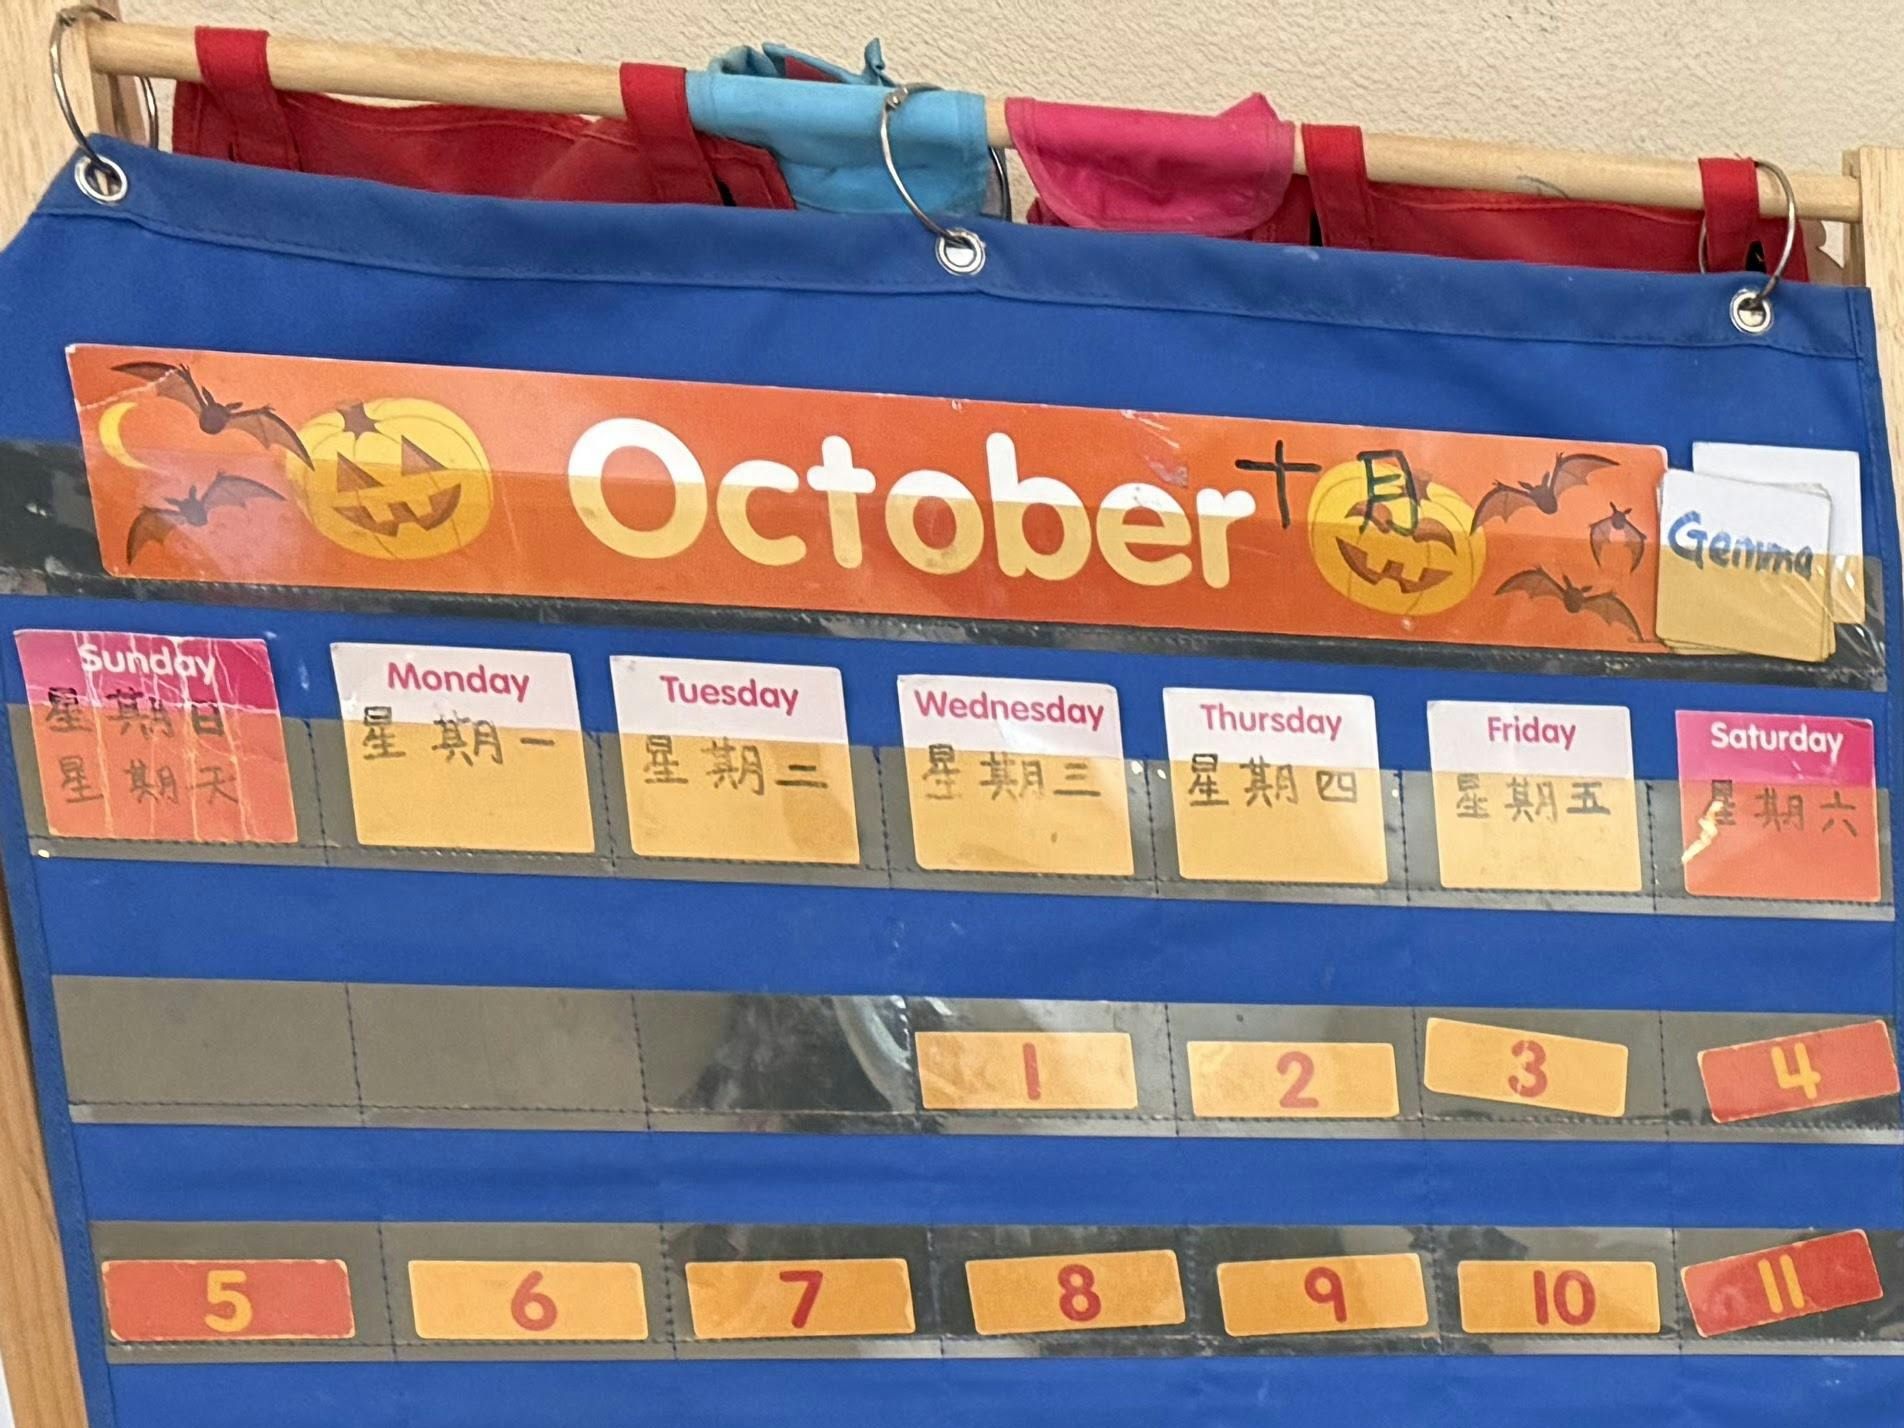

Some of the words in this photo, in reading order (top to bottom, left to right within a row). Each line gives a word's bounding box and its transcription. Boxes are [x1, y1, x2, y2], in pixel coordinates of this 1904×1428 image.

[567, 417, 1254, 589] October
[1235, 441, 1418, 535] 十月
[1667, 510, 1814, 582] Gemma
[82, 643, 216, 685] Sunday
[387, 662, 530, 703] Monday
[659, 675, 799, 717] Tuesday
[914, 689, 1104, 732] Wednesday
[1200, 703, 1343, 741] Thursday
[362, 705, 556, 767] 星期一
[1487, 715, 1576, 751] Friday
[1710, 721, 1844, 765] Saturday
[57, 754, 240, 804] 星期天
[643, 734, 829, 796] 星期二
[921, 743, 1102, 800] 星期三
[1188, 753, 1358, 808] 星期四
[1455, 773, 1612, 824] 星期五
[1701, 779, 1858, 838] 星期六
[1021, 1042, 1042, 1101] 1
[1277, 1050, 1320, 1110] 2
[1507, 1038, 1550, 1099] 3
[1768, 1040, 1823, 1100] 4
[203, 1269, 254, 1333] 5
[509, 1271, 559, 1332] 6
[778, 1269, 825, 1330] 7
[1057, 1262, 1102, 1322] 8
[1303, 1266, 1348, 1323] 9
[1532, 1268, 1597, 1327] 10
[1757, 1255, 1806, 1316] 11
